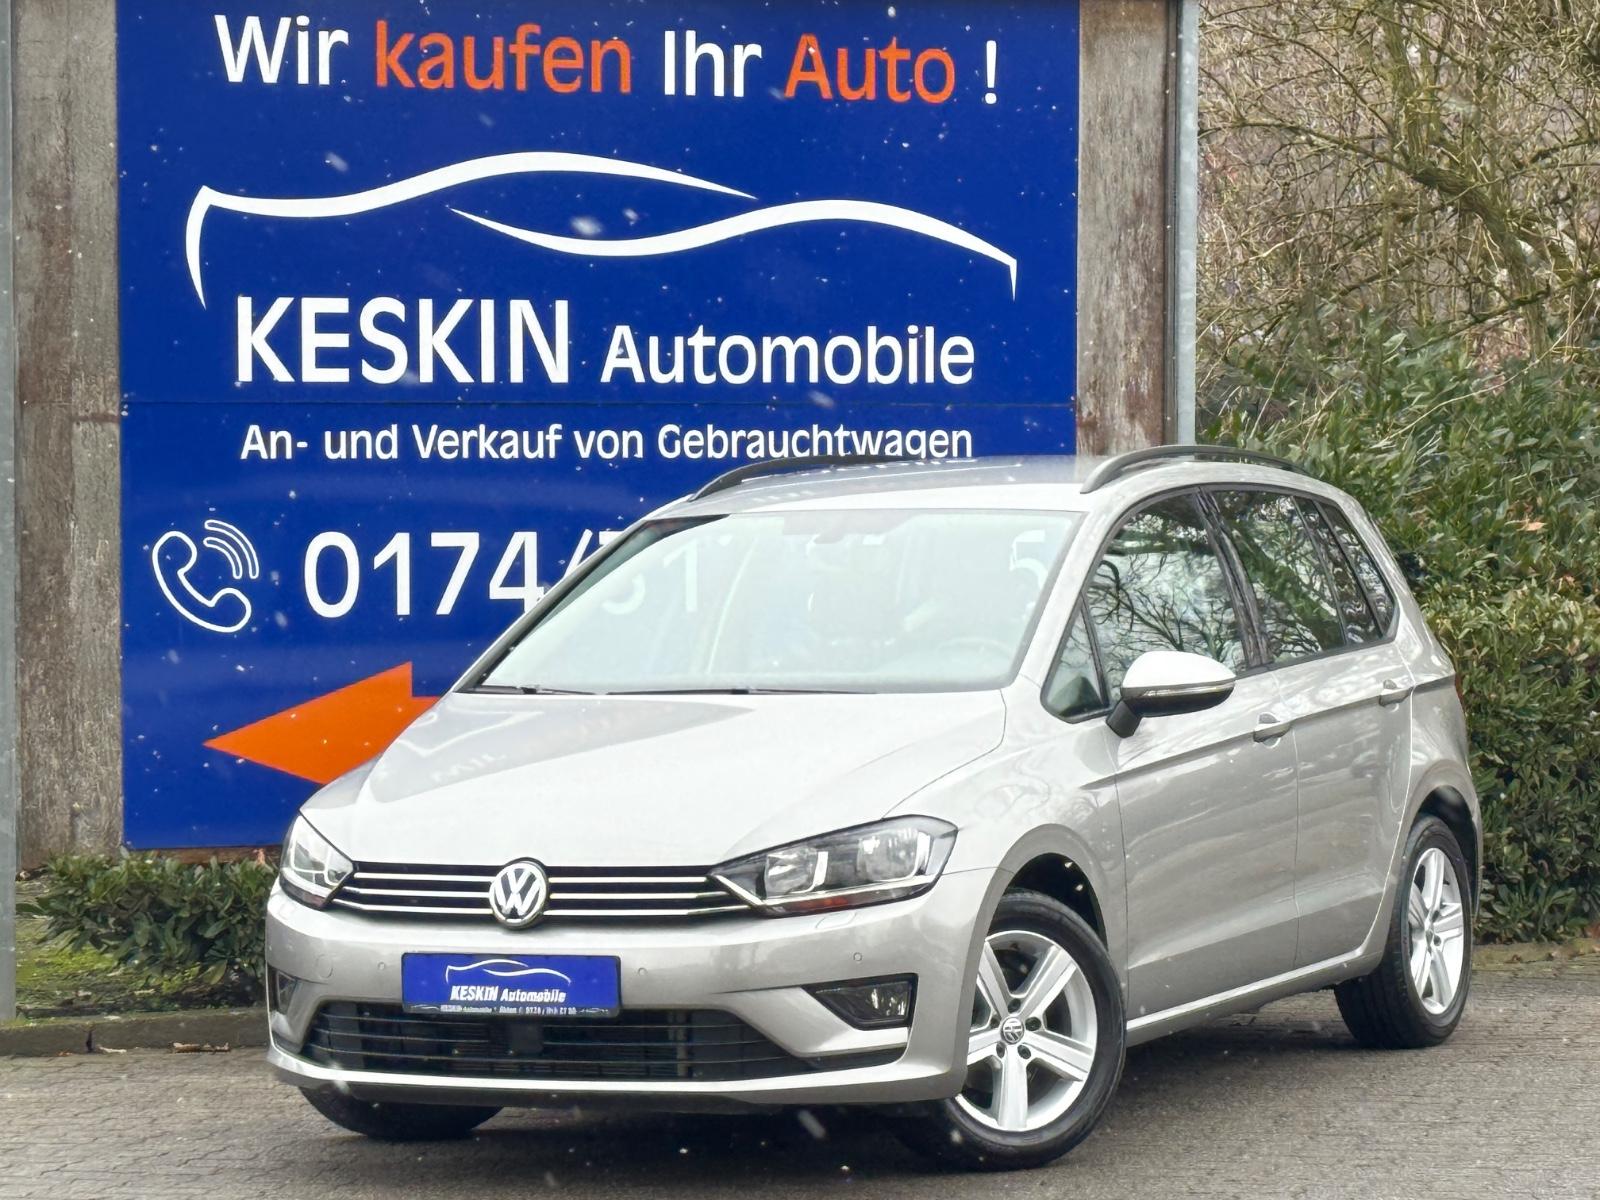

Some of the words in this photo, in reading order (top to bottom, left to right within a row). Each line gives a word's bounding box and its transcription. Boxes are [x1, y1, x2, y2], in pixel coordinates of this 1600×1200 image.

[214, 15, 348, 85] Wir
[375, 20, 632, 93] kaufen
[664, 30, 762, 98] Ihr
[784, 34, 956, 104] Auto
[984, 40, 997, 105] !
[237, 295, 569, 385] KESKIN
[601, 324, 975, 385] Automobile
[241, 424, 308, 460] An-
[324, 424, 398, 460] und
[412, 423, 563, 460] Verkauf
[573, 429, 644, 460] von
[658, 423, 973, 460] Gebrauchtwagen
[450, 985, 499, 1001] KESKIN
[500, 988, 566, 1003] Automobile
